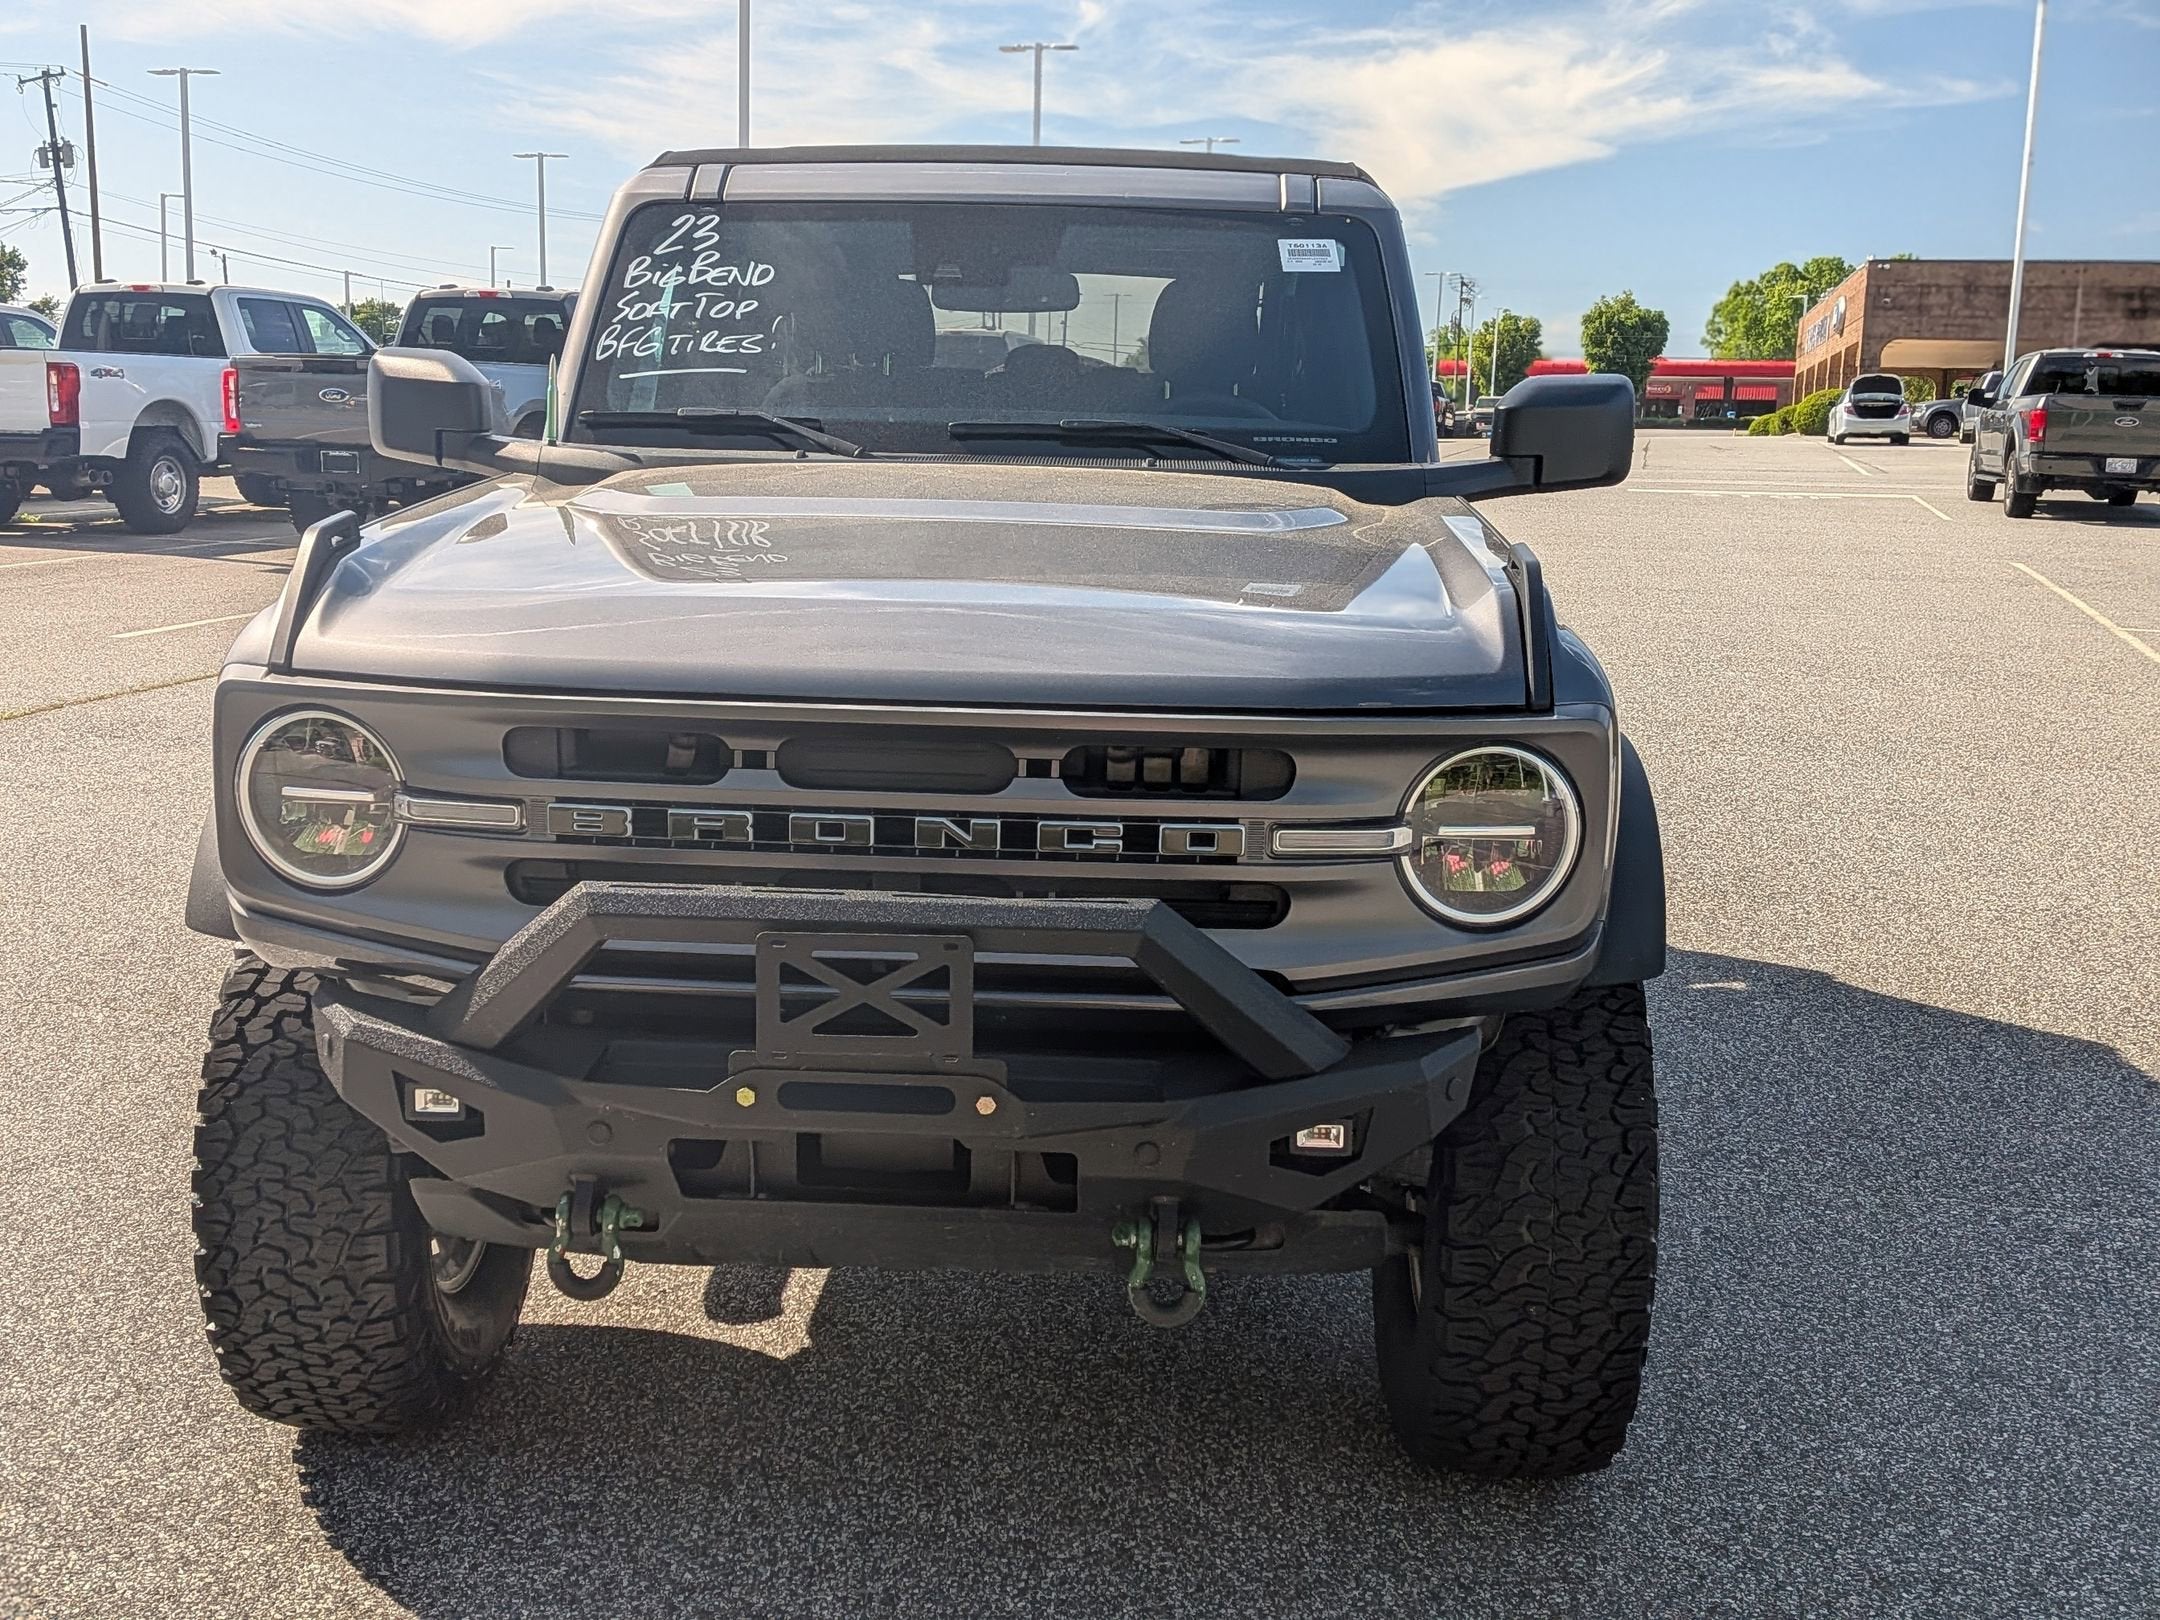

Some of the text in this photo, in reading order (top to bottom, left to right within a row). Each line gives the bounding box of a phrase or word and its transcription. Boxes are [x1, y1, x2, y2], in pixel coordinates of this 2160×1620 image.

[653, 214, 720, 255] 23
[695, 292, 758, 320] TOP
[547, 802, 1246, 858] BRONCO
